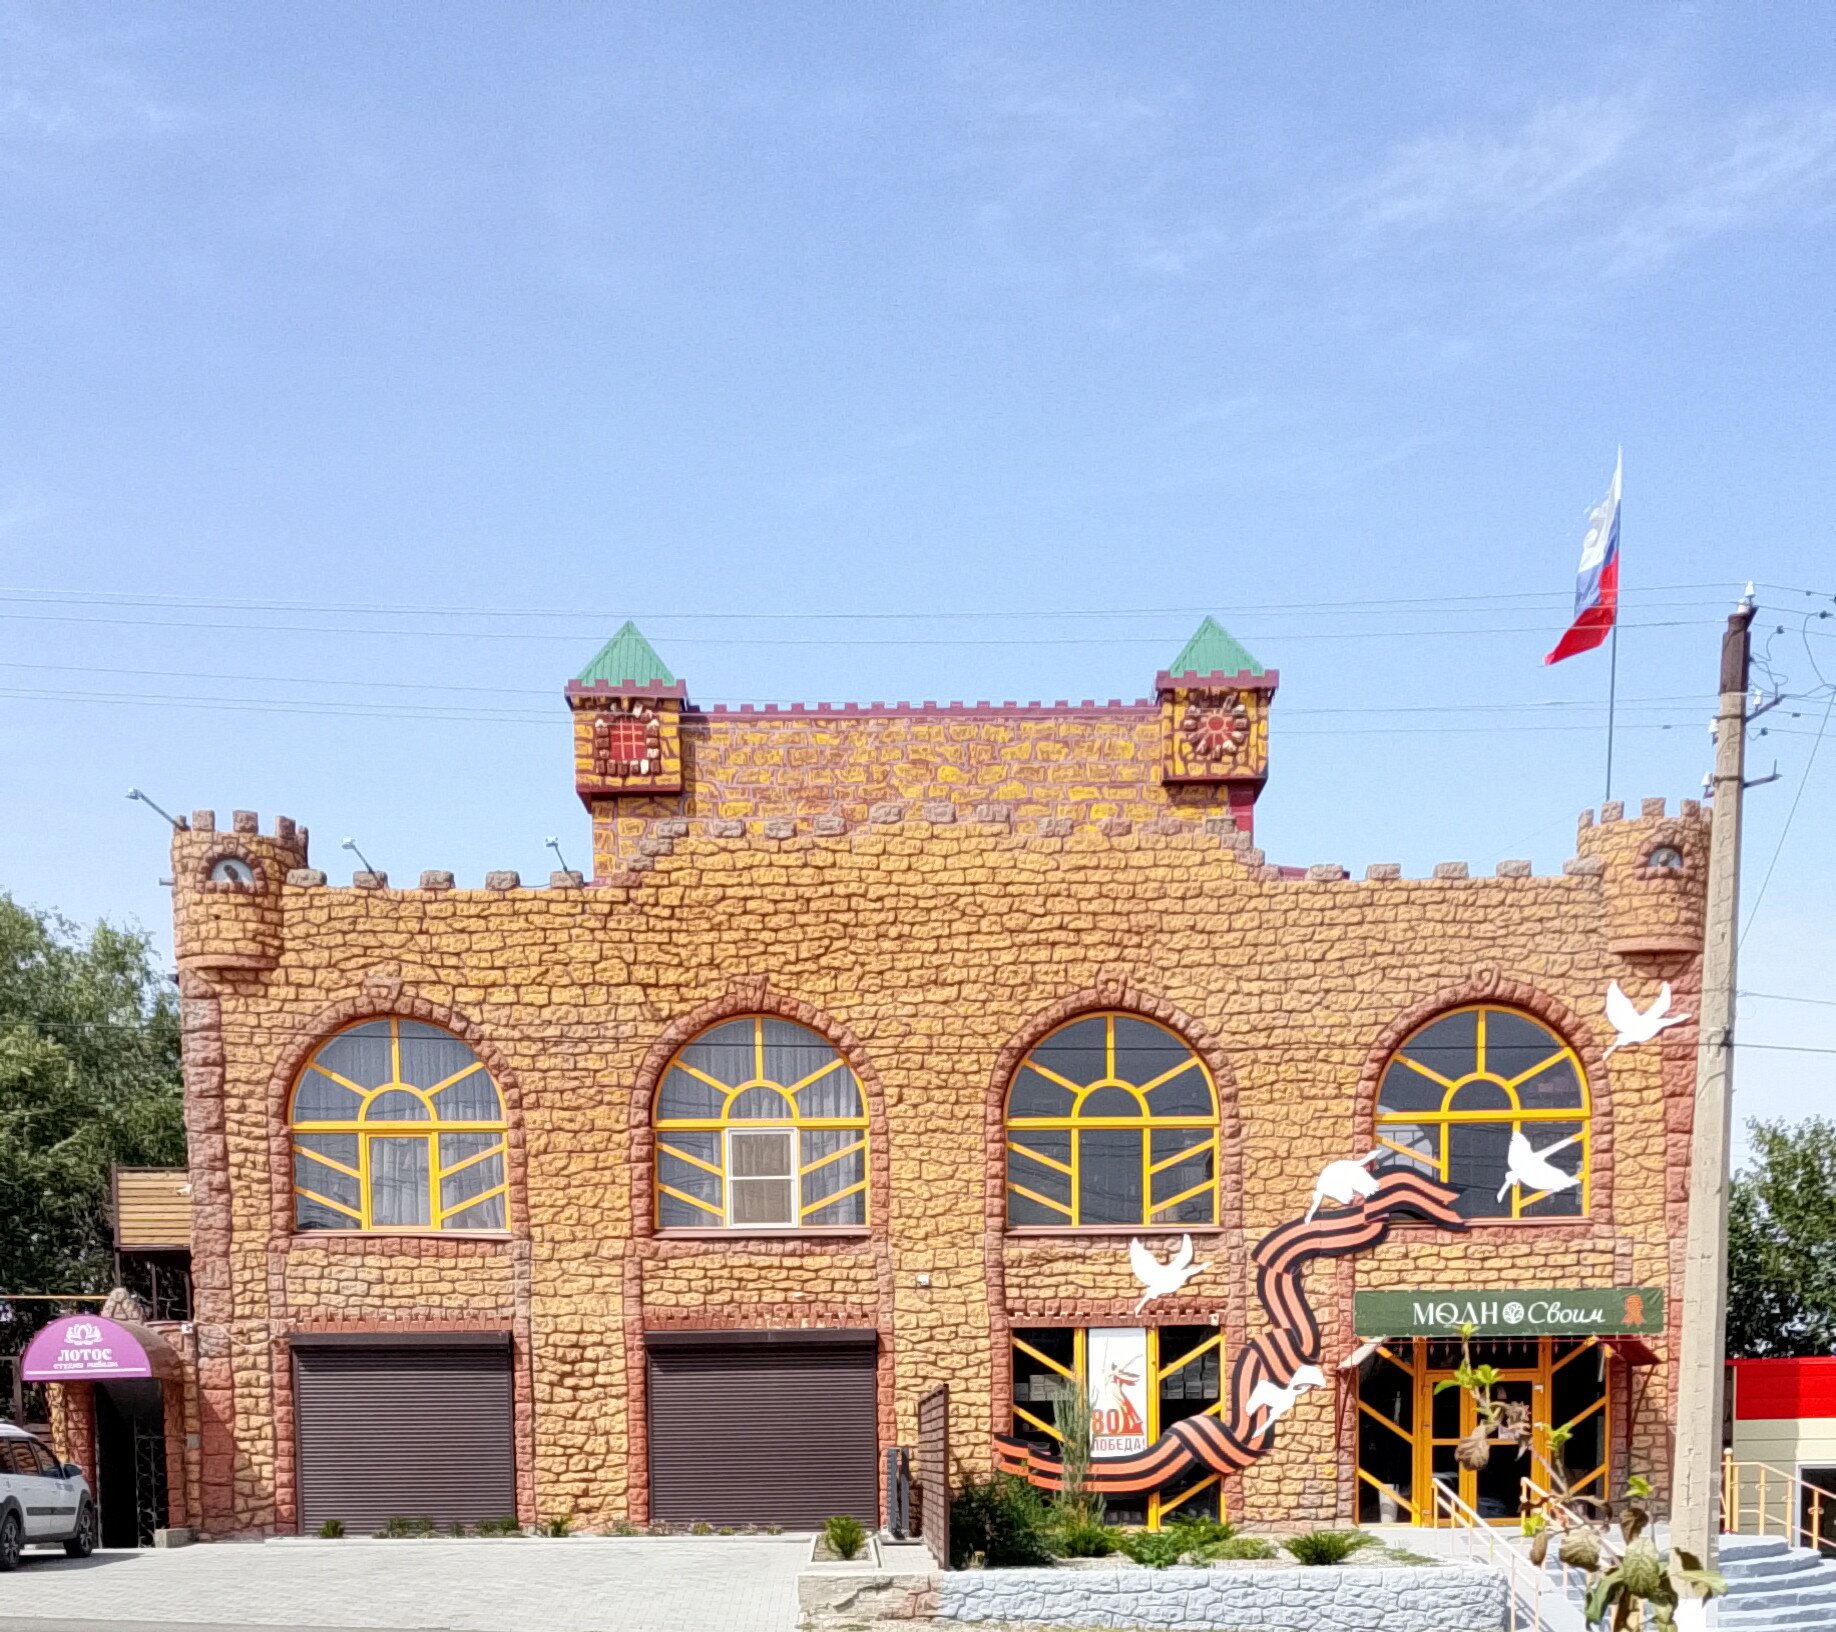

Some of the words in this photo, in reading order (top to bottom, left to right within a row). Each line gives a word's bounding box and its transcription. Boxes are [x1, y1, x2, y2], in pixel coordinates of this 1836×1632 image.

[1527, 1301, 1606, 1324] Своим
[57, 1348, 113, 1362] ЛОТОС
[1091, 1408, 1120, 1436] 80
